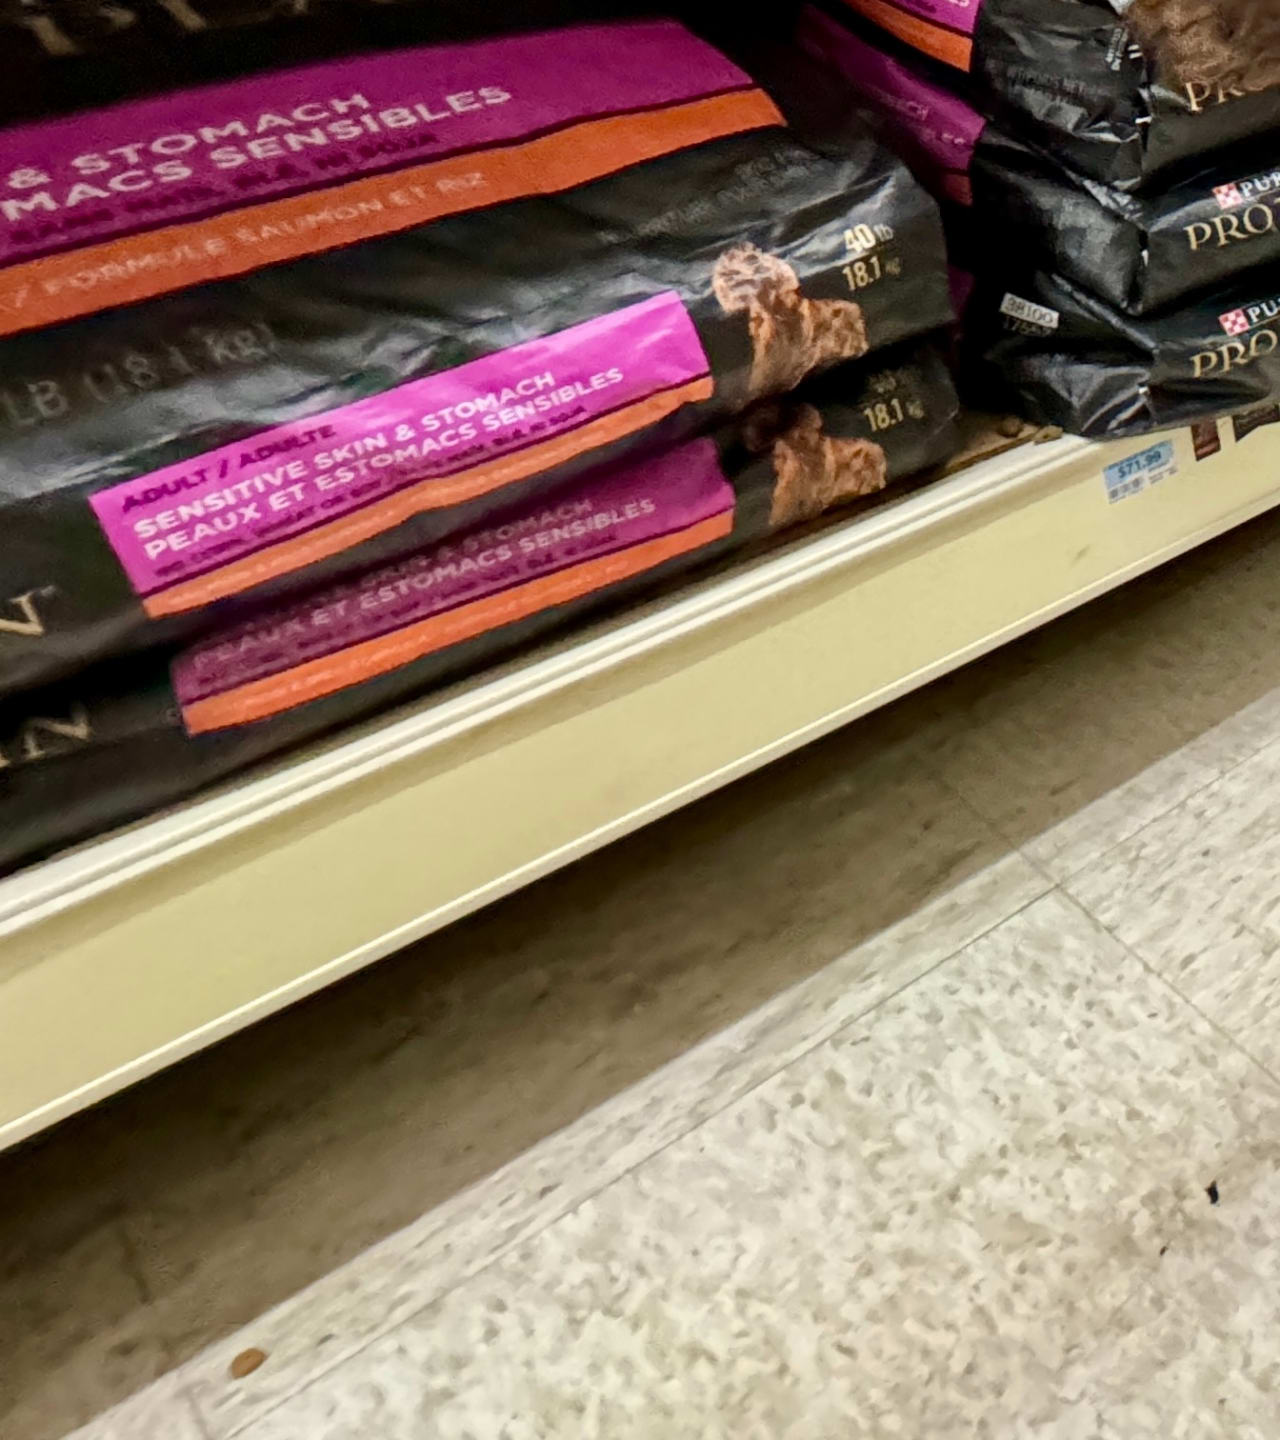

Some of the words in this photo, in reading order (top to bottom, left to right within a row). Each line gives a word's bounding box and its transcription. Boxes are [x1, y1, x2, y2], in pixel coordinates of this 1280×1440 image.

[8, 166, 53, 190] &
[71, 92, 373, 176] STOMACH
[209, 85, 513, 170] SENSIBLES
[843, 222, 877, 254] 40
[875, 223, 895, 243] lb
[1183, 202, 1274, 252] PRO
[842, 255, 882, 292] 18.1
[1190, 328, 1279, 379] PRO
[132, 460, 310, 540] SENSITIVE
[313, 431, 389, 471] SKIN
[394, 423, 417, 442] &
[420, 370, 556, 432] STOMACH
[863, 397, 904, 433] 18.1
[122, 468, 209, 514] ADULT
[217, 459, 229, 480] /
[238, 424, 337, 469] ADULTE
[143, 501, 263, 560] PEAUX
[267, 481, 307, 512] ET
[313, 422, 478, 491] ESTOMACS
[481, 366, 625, 433] SENSIBLES
[309, 603, 348, 628] ET
[359, 544, 513, 611] ESTOMACS
[517, 498, 657, 553] SENSIBLES
